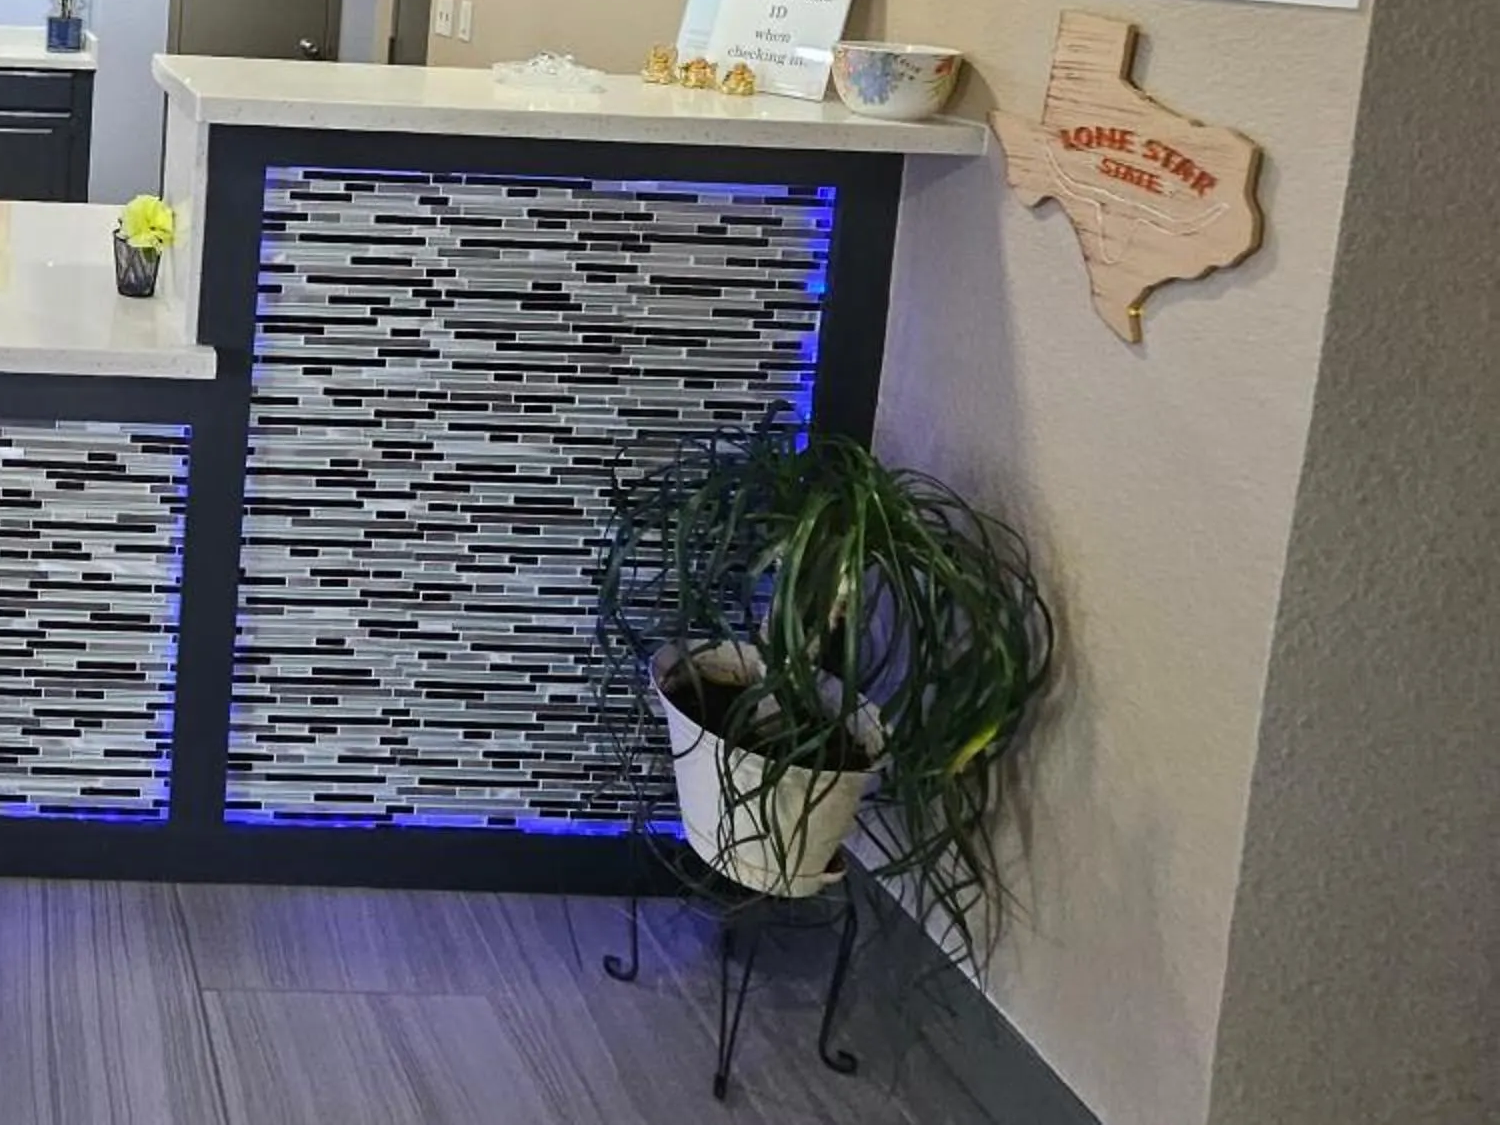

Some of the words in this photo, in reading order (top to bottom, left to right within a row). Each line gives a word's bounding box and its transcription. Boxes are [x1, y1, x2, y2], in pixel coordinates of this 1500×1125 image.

[769, 5, 788, 19] ID
[755, 28, 791, 43] when
[727, 45, 788, 65] checking
[1059, 126, 1136, 154] LONE
[1142, 139, 1218, 197] STAR
[1097, 158, 1165, 194] STATE
